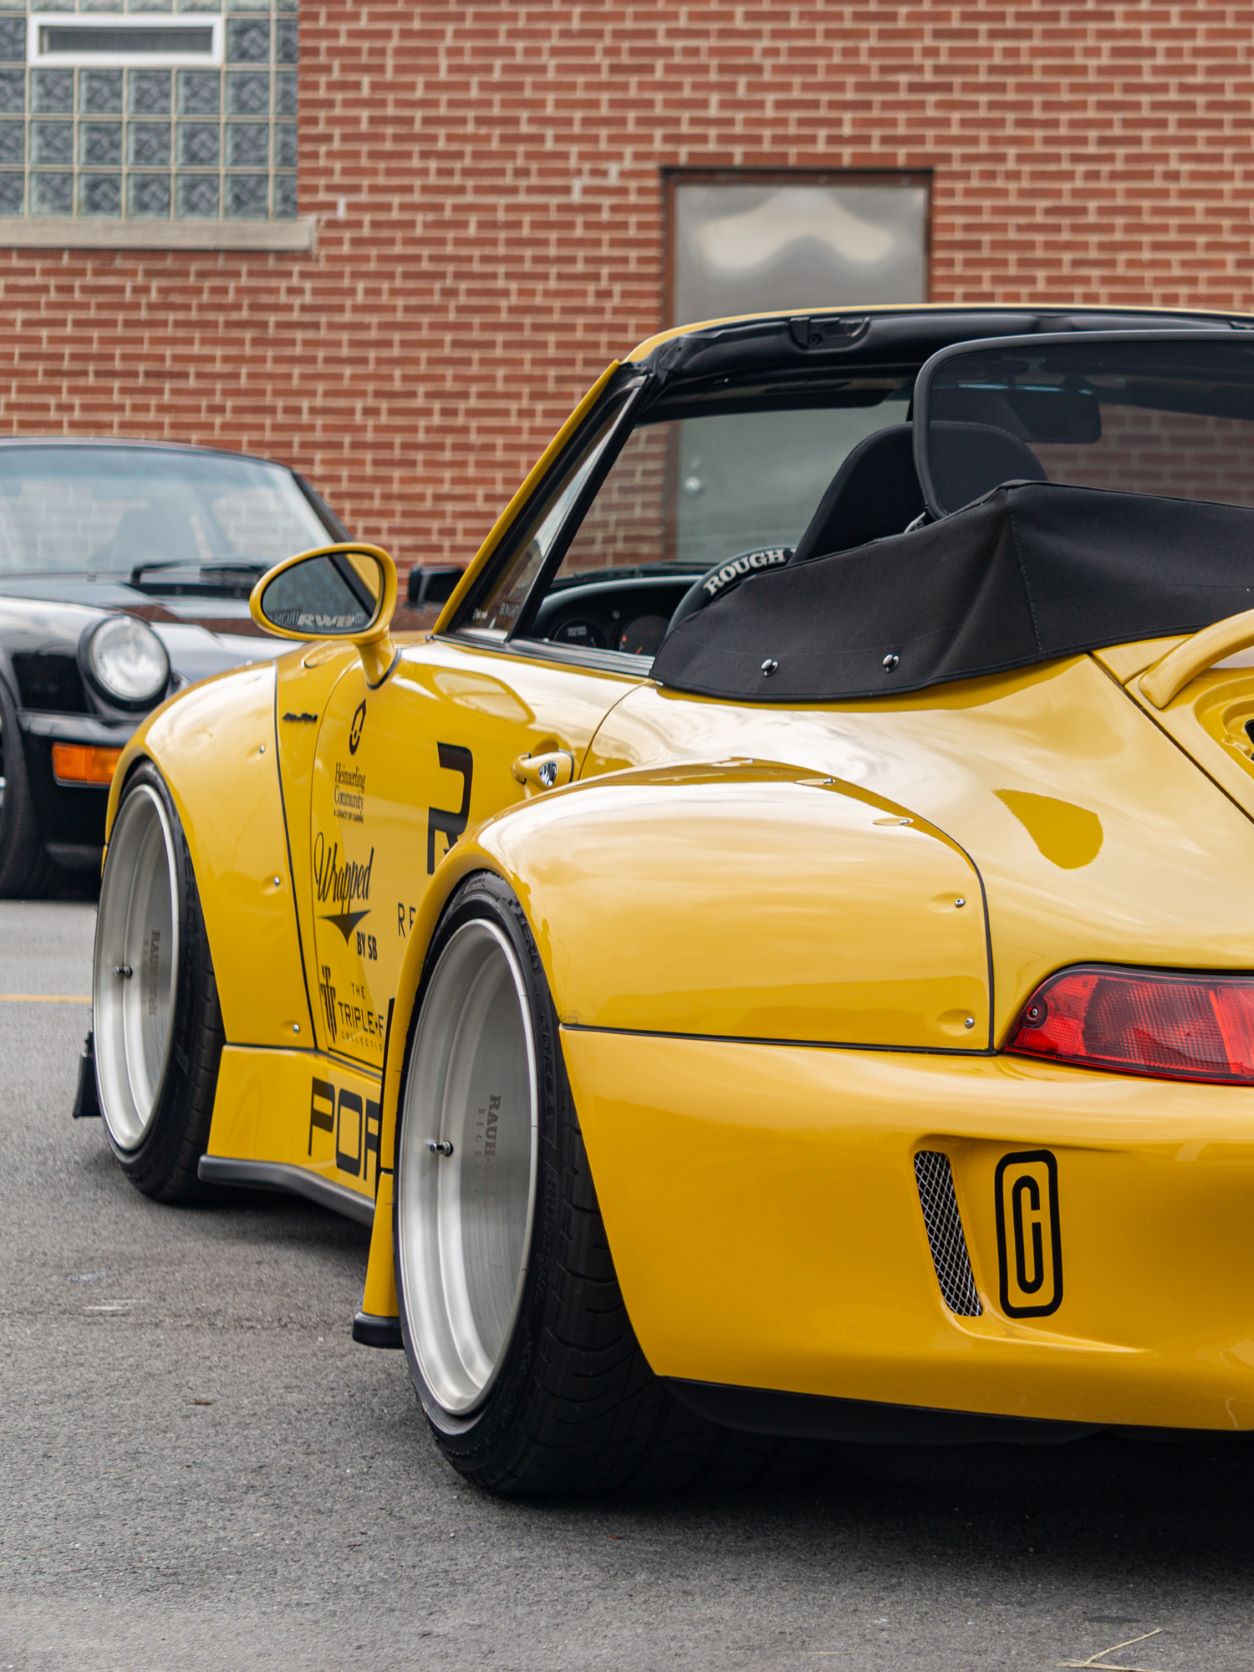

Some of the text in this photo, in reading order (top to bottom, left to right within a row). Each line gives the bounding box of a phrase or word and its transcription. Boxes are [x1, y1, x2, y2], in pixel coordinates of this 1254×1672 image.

[703, 549, 786, 596] ROUGH
[334, 784, 364, 814] Community
[313, 831, 375, 915] Wrapped
[356, 930, 378, 961] BY SB
[351, 982, 366, 1000] THE
